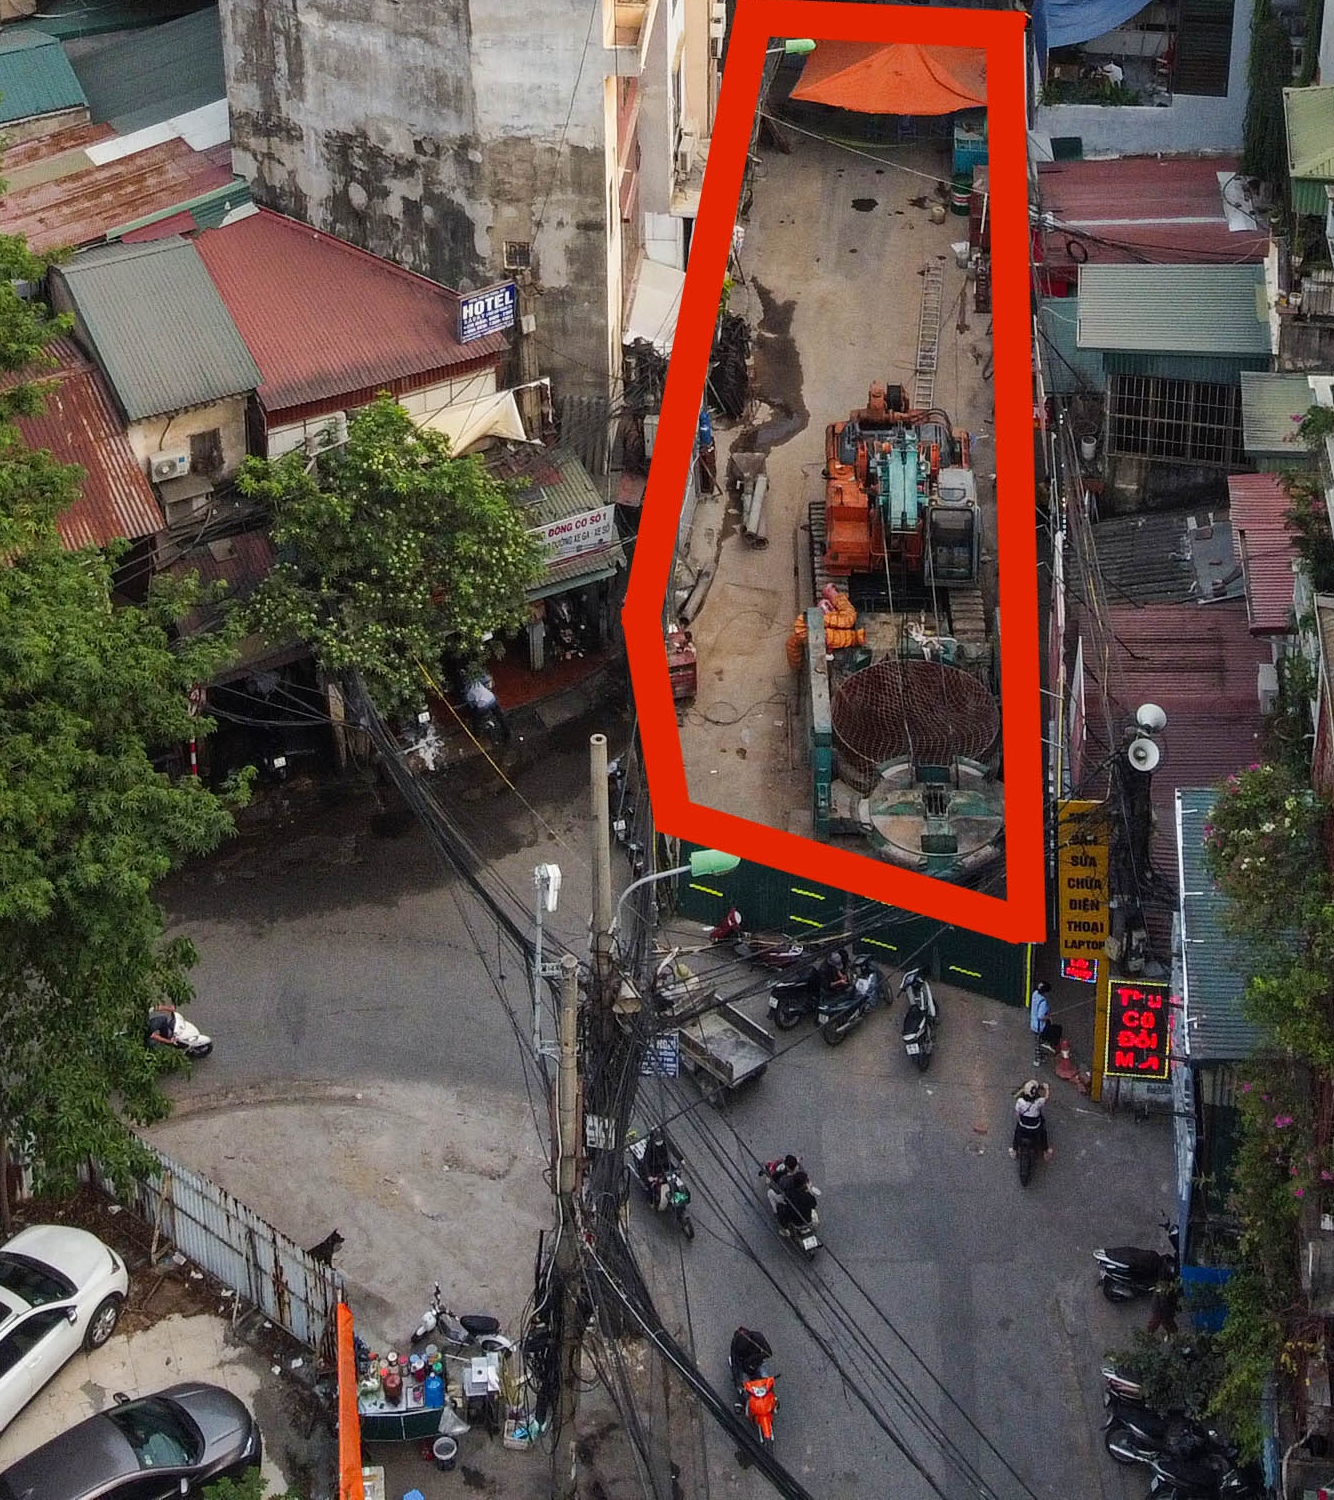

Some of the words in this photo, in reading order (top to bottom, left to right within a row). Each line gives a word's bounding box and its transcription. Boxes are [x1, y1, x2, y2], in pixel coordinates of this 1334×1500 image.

[462, 290, 514, 321] HOTEL
[1067, 920, 1105, 935] THOẠI
[1064, 939, 1106, 951] LAPTOP
